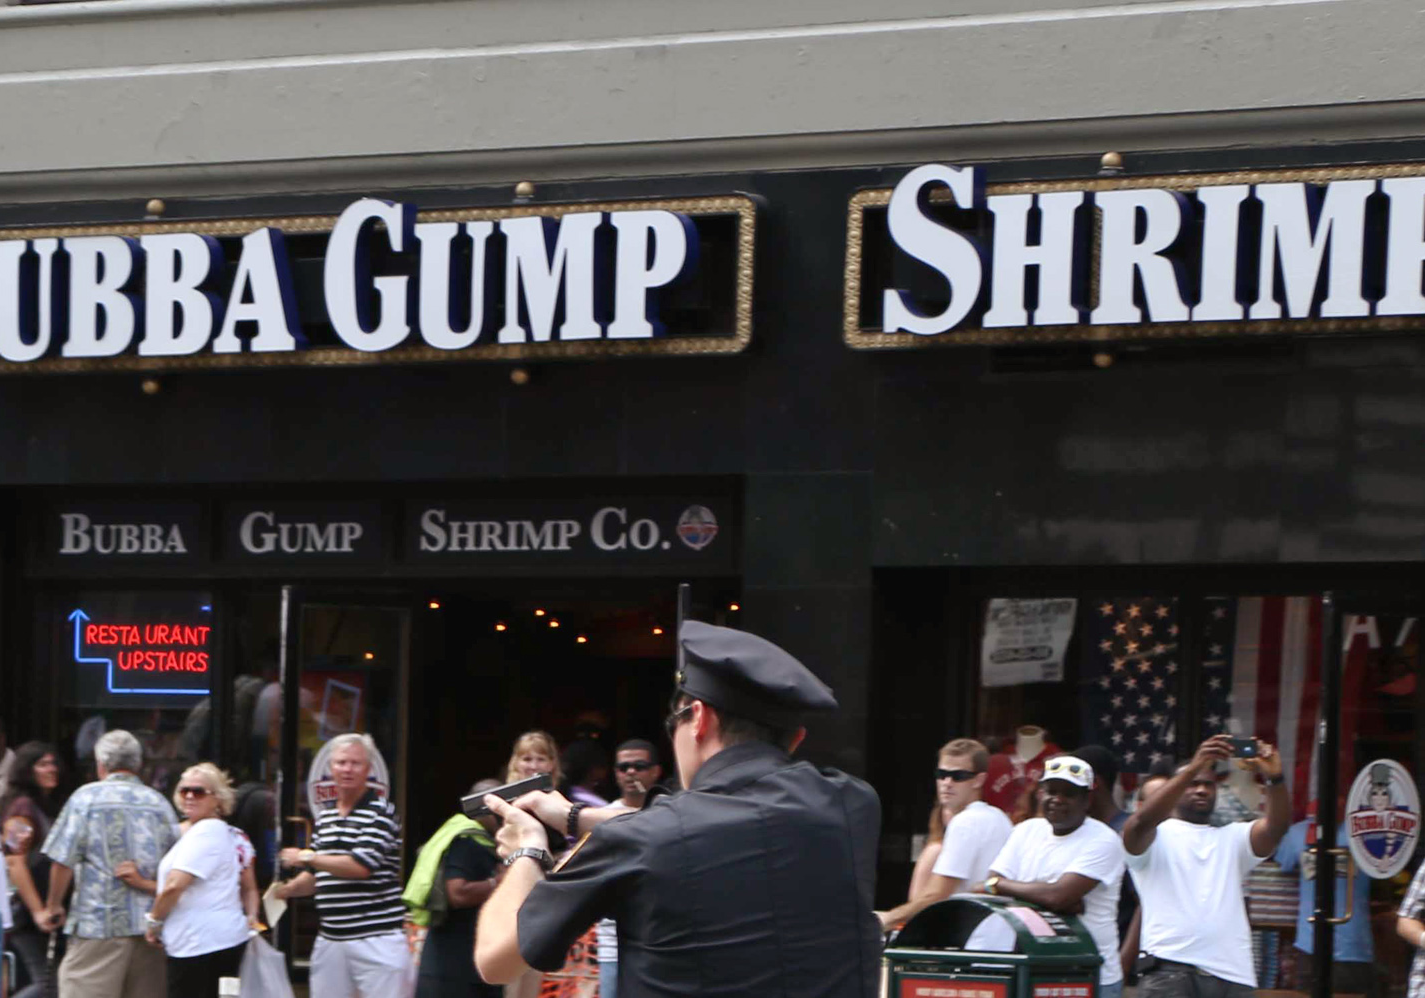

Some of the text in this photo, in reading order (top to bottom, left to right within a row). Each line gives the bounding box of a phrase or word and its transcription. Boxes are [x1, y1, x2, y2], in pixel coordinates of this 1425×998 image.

[323, 197, 698, 353] GUMP
[59, 512, 189, 555] BUBBA
[239, 510, 364, 554] GUMP
[419, 508, 582, 552] SHRIMP
[118, 650, 210, 673] UPSTAIRS
